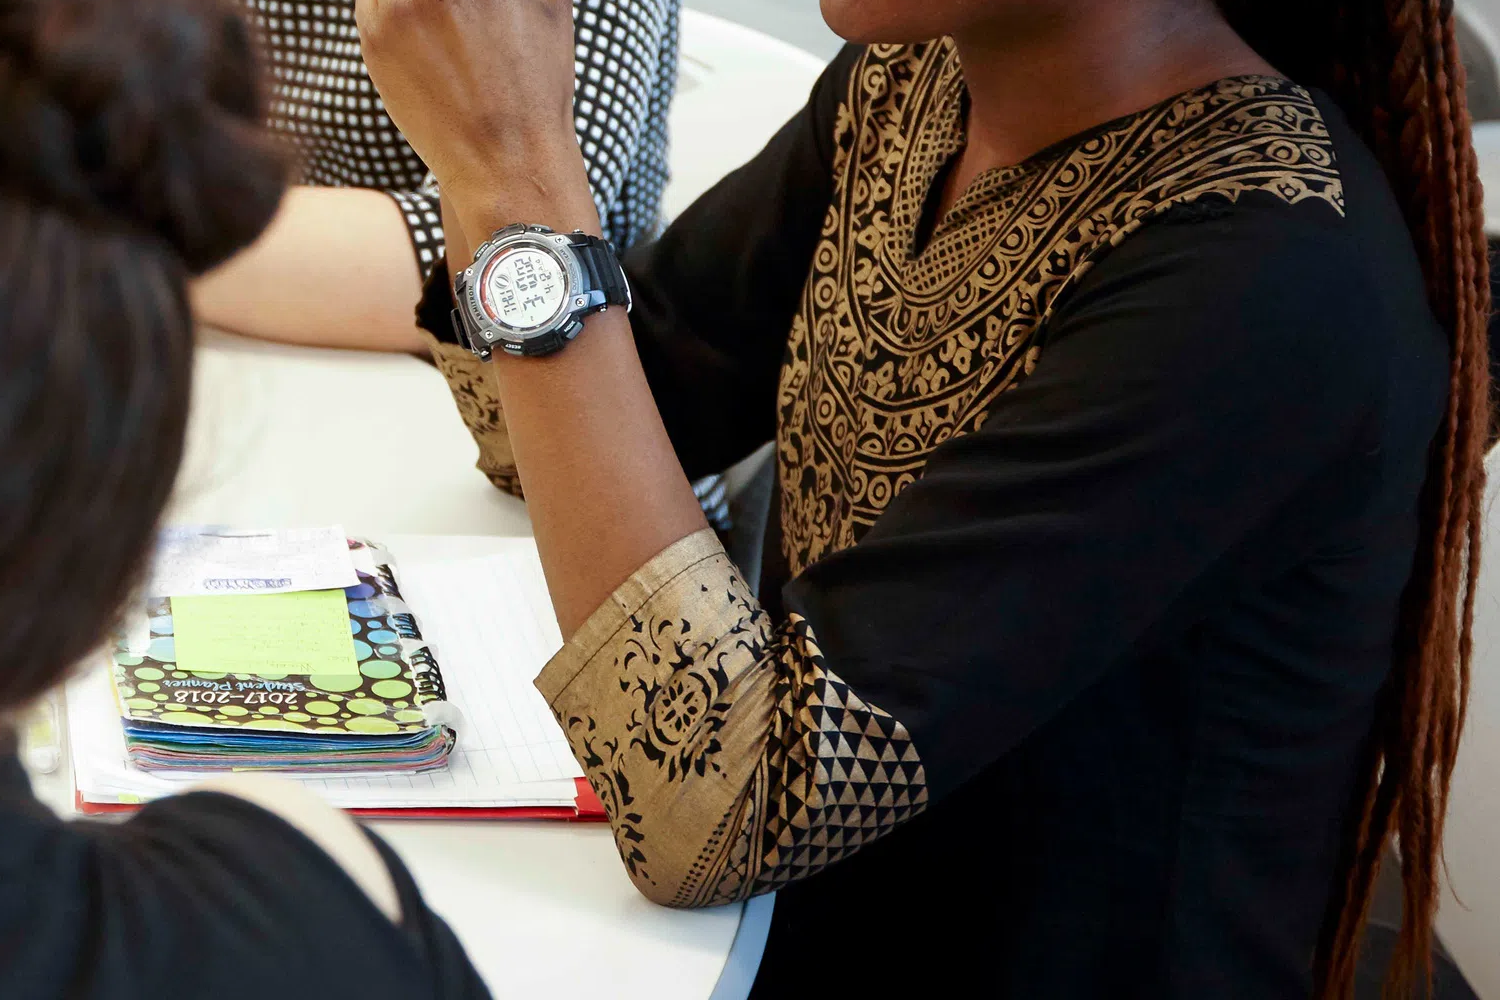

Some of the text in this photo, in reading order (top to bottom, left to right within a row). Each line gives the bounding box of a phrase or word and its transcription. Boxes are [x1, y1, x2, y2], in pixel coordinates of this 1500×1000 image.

[468, 285, 485, 321] ARMITRON
[162, 679, 306, 694] Student Planner
